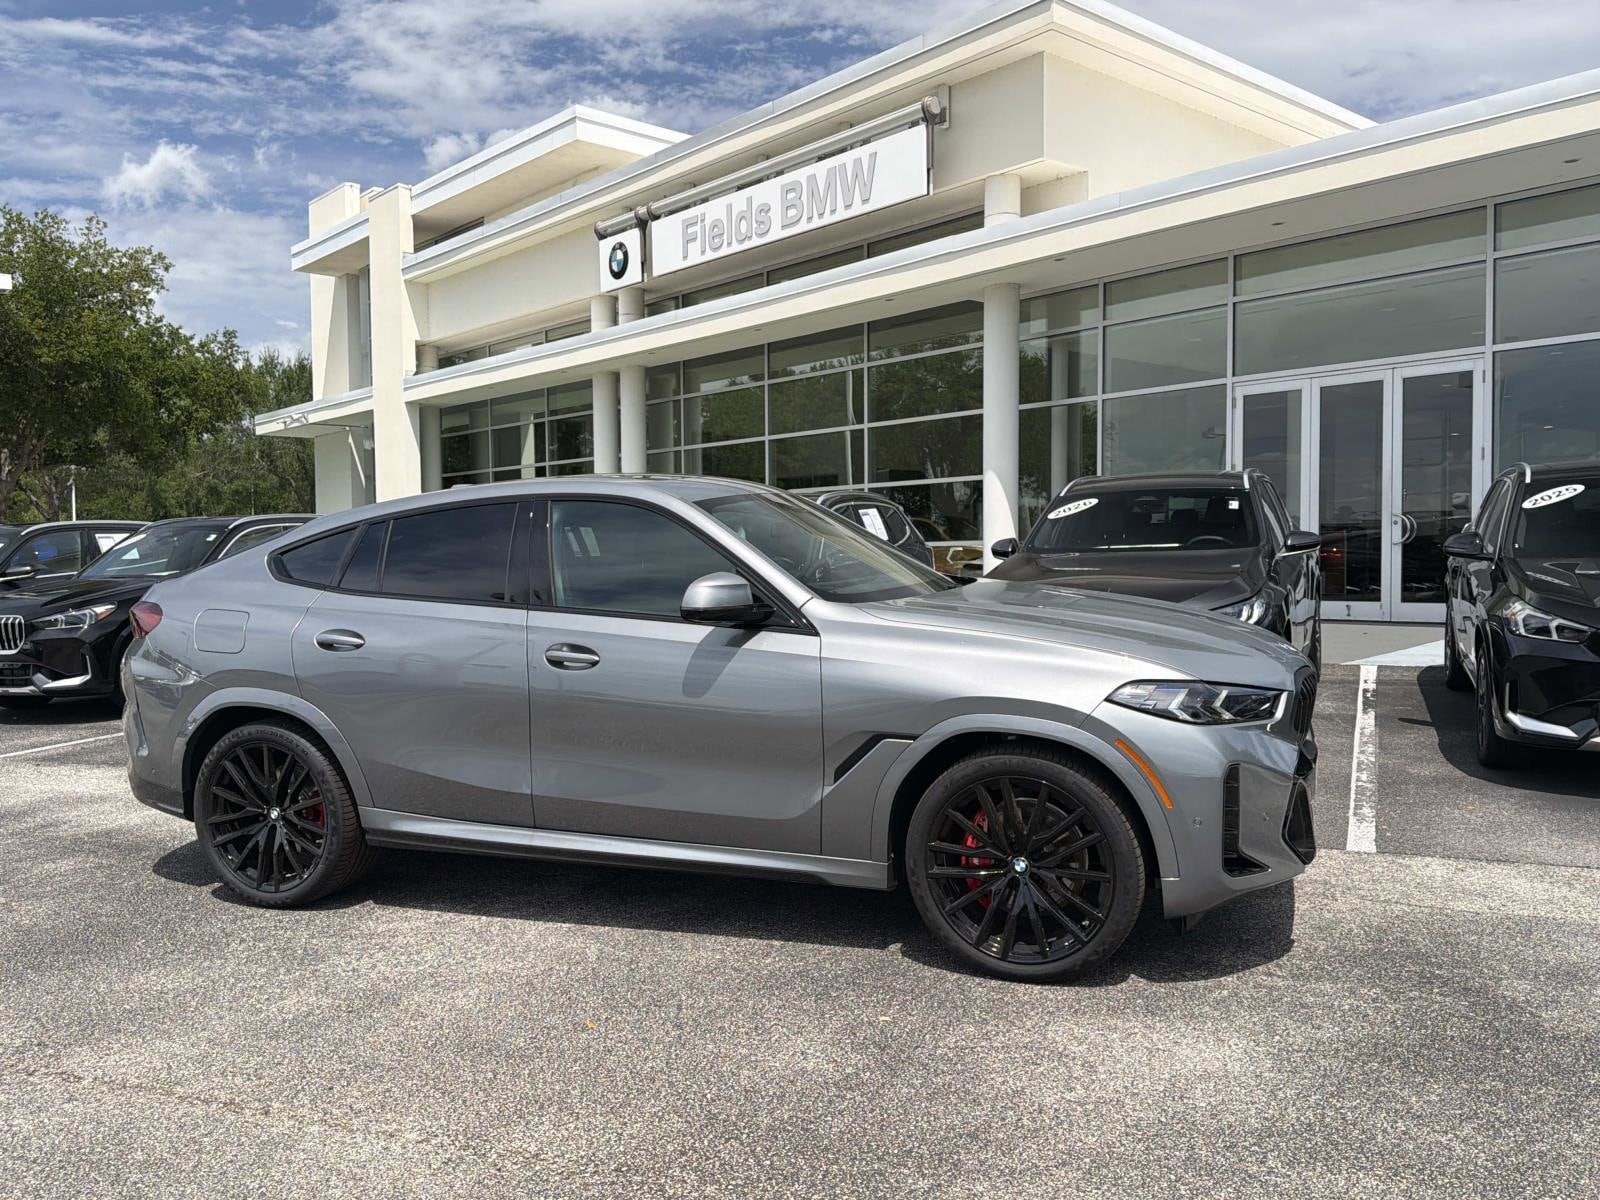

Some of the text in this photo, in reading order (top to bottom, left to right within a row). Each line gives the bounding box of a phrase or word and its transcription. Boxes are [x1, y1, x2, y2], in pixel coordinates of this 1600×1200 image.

[681, 151, 878, 261] Fields BMW
[1527, 486, 1578, 506] 2025
[1053, 500, 1093, 517] 2026
